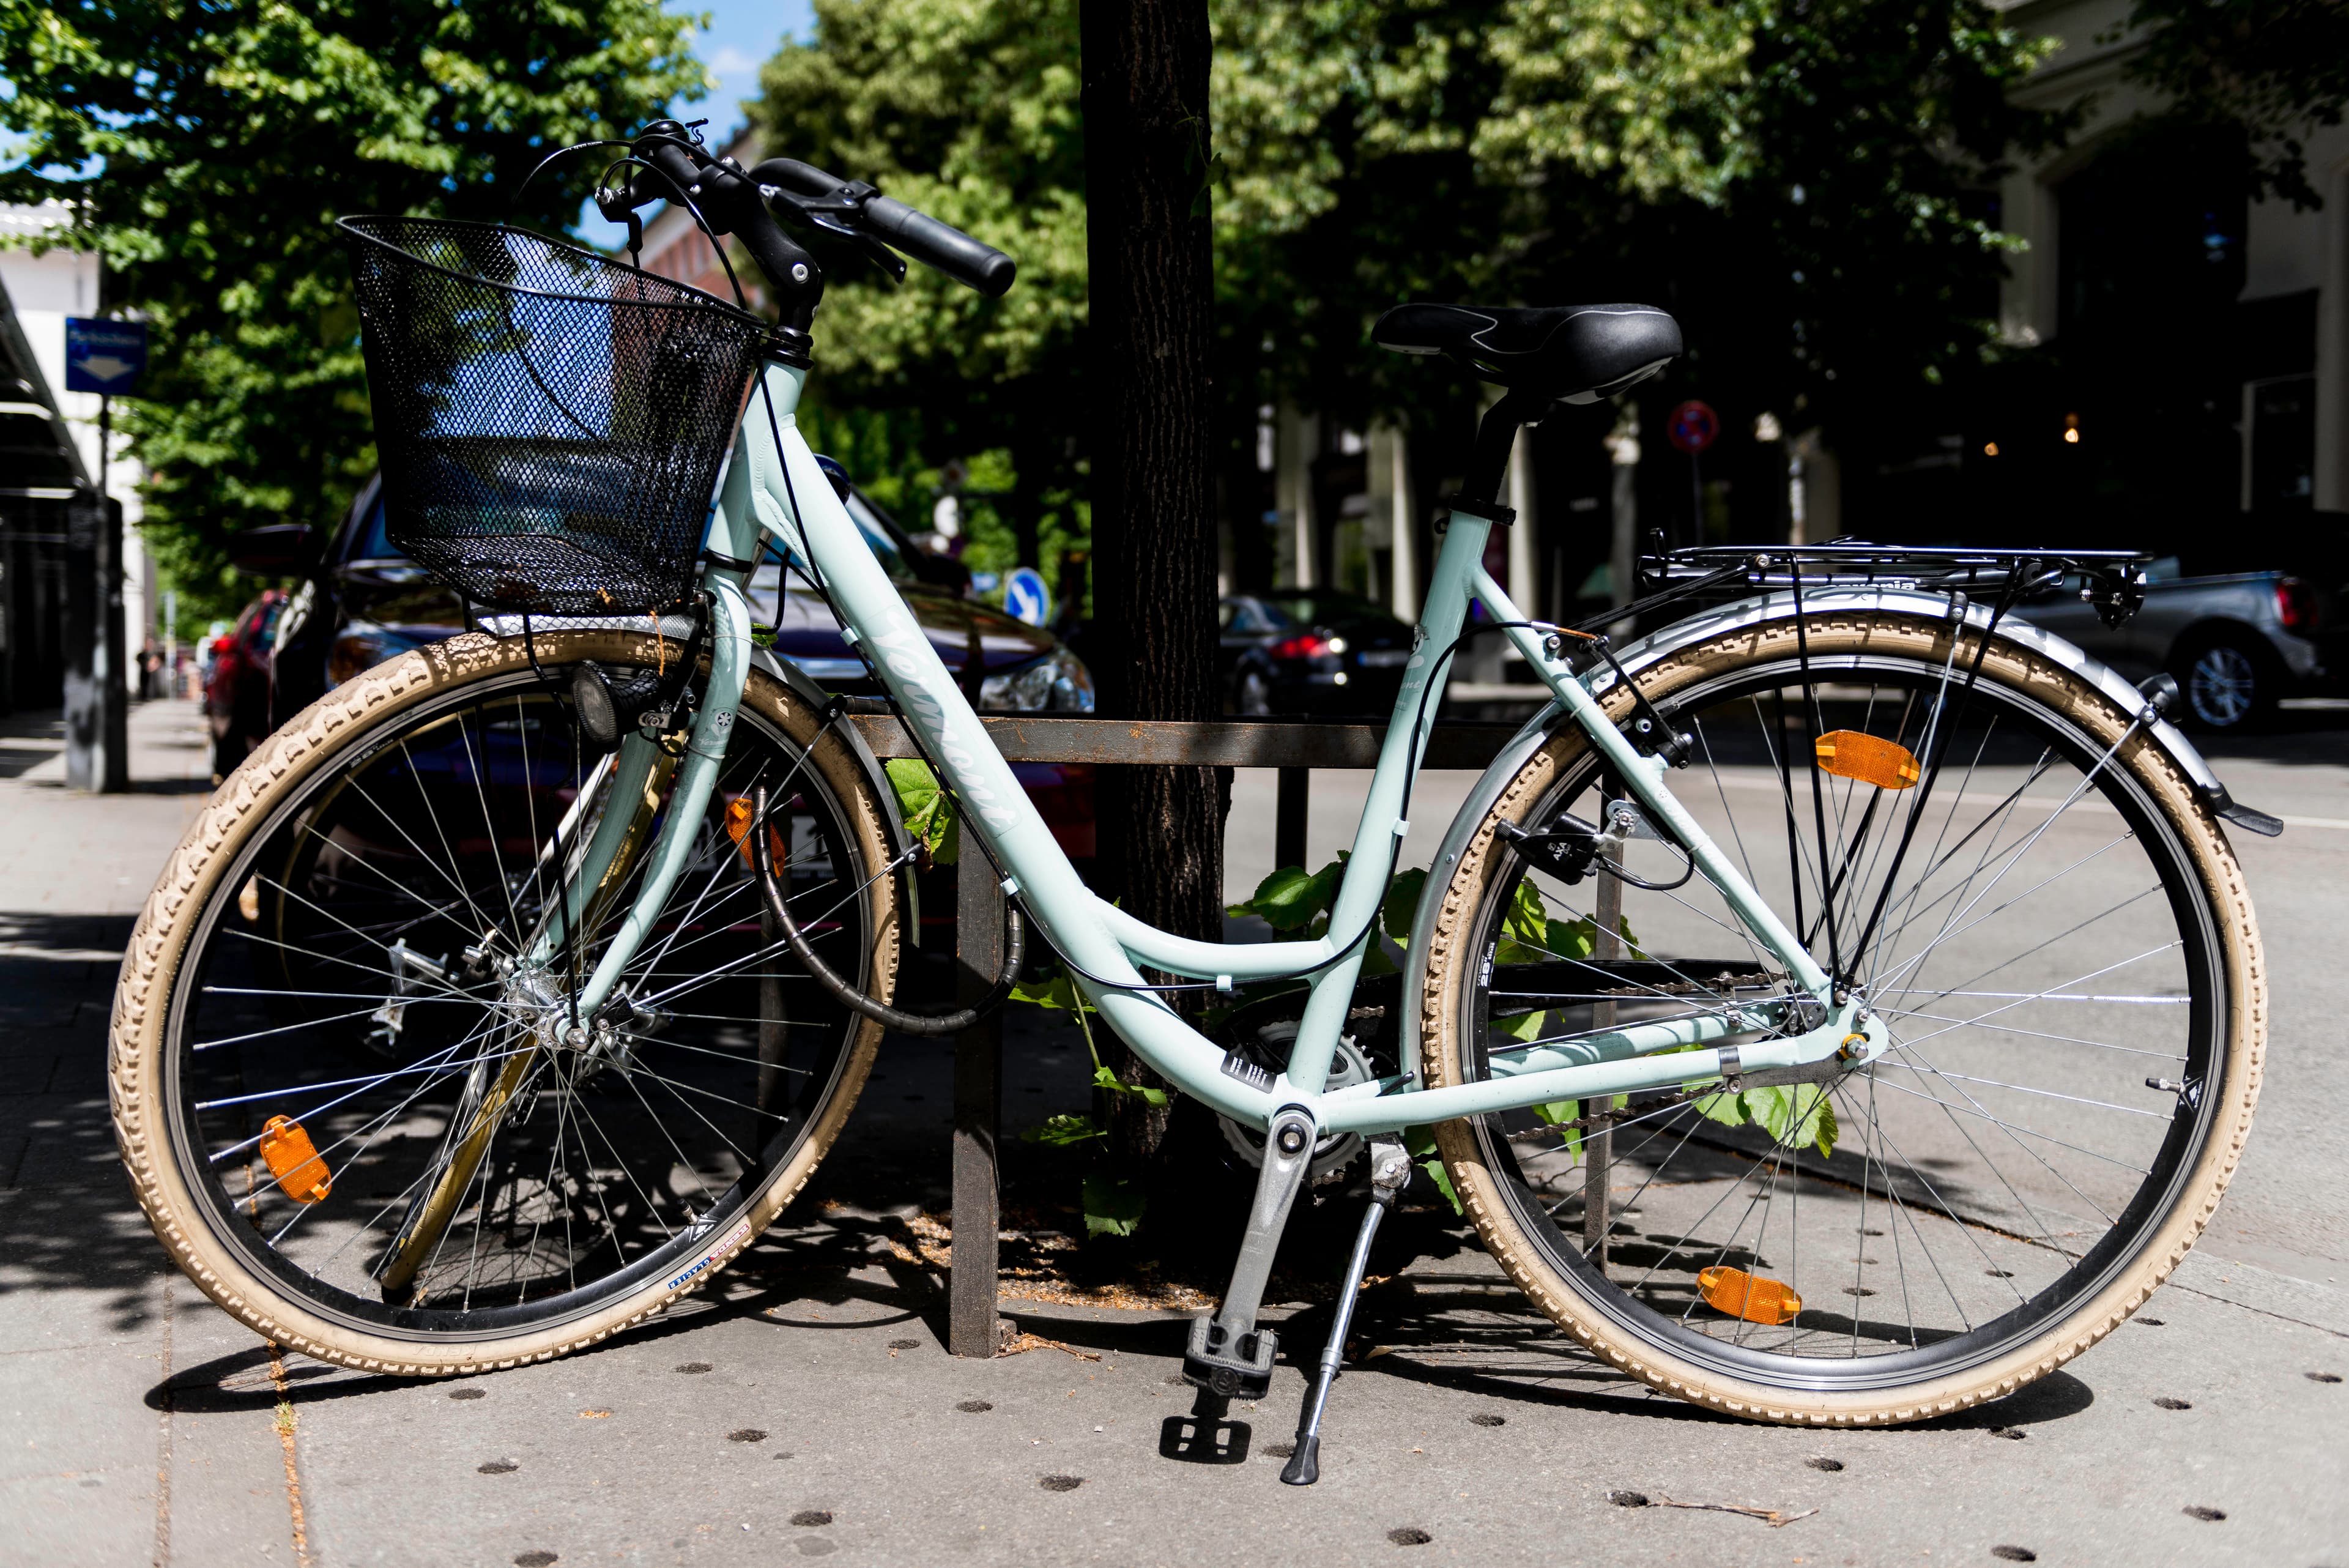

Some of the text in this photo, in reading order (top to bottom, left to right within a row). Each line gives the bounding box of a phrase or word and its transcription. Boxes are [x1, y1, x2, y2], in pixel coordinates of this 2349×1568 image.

[871, 611, 1016, 828] Vermont
[1553, 842, 1567, 861] AXA
[670, 1224, 749, 1288] KENDA GLACIER
[1502, 1210, 1545, 1268] KENDA
